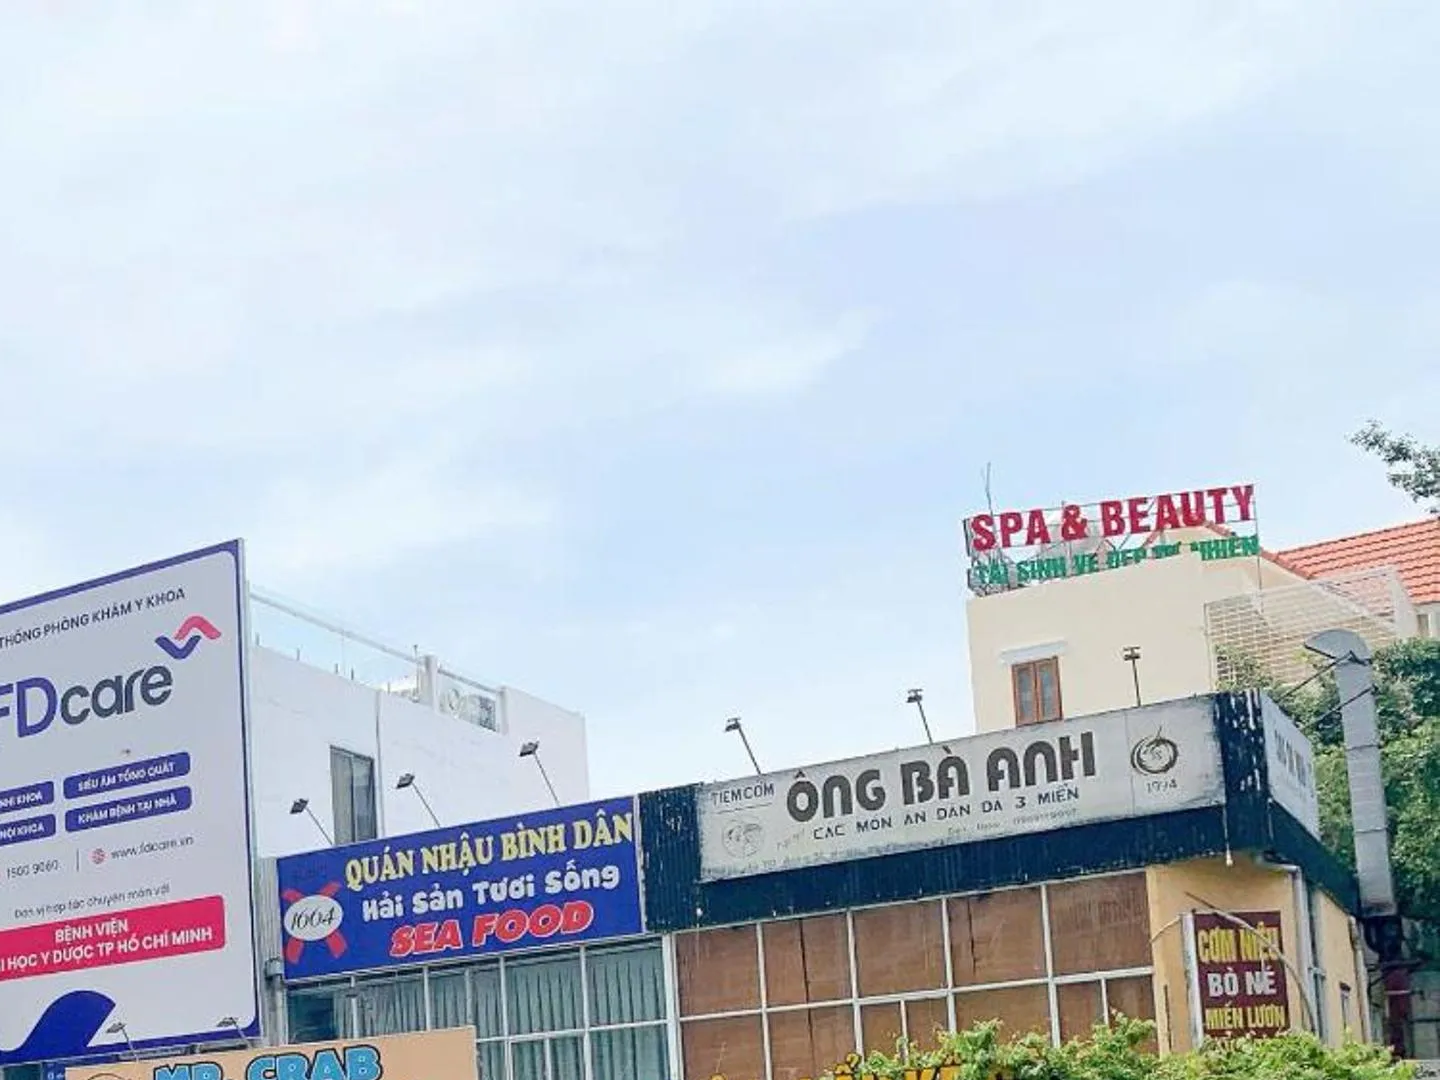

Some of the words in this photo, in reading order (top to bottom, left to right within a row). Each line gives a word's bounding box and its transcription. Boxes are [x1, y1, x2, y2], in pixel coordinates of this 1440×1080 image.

[970, 509, 1051, 551] SPA
[1061, 504, 1088, 542] &
[1100, 484, 1256, 538] BEAUTY
[135, 598, 144, 611] Y
[146, 587, 186, 609] KHOA
[786, 769, 887, 823] ÔNG
[899, 745, 970, 806] BÀ
[986, 731, 1096, 793] ANH
[1015, 796, 1027, 809] 3
[345, 846, 415, 891] QUÁN
[422, 833, 494, 877] NHẬU
[500, 822, 567, 861] BÌNH
[573, 807, 635, 850] DÂN
[362, 887, 403, 923] Hải
[472, 874, 536, 906] Tươi
[41, 952, 51, 966] Y
[96, 941, 114, 957] TP
[172, 926, 213, 947] MINH
[390, 921, 463, 957] SEA
[472, 900, 594, 948] FOOD
[1207, 966, 1239, 997] BÒ
[1245, 964, 1278, 996] NÉ
